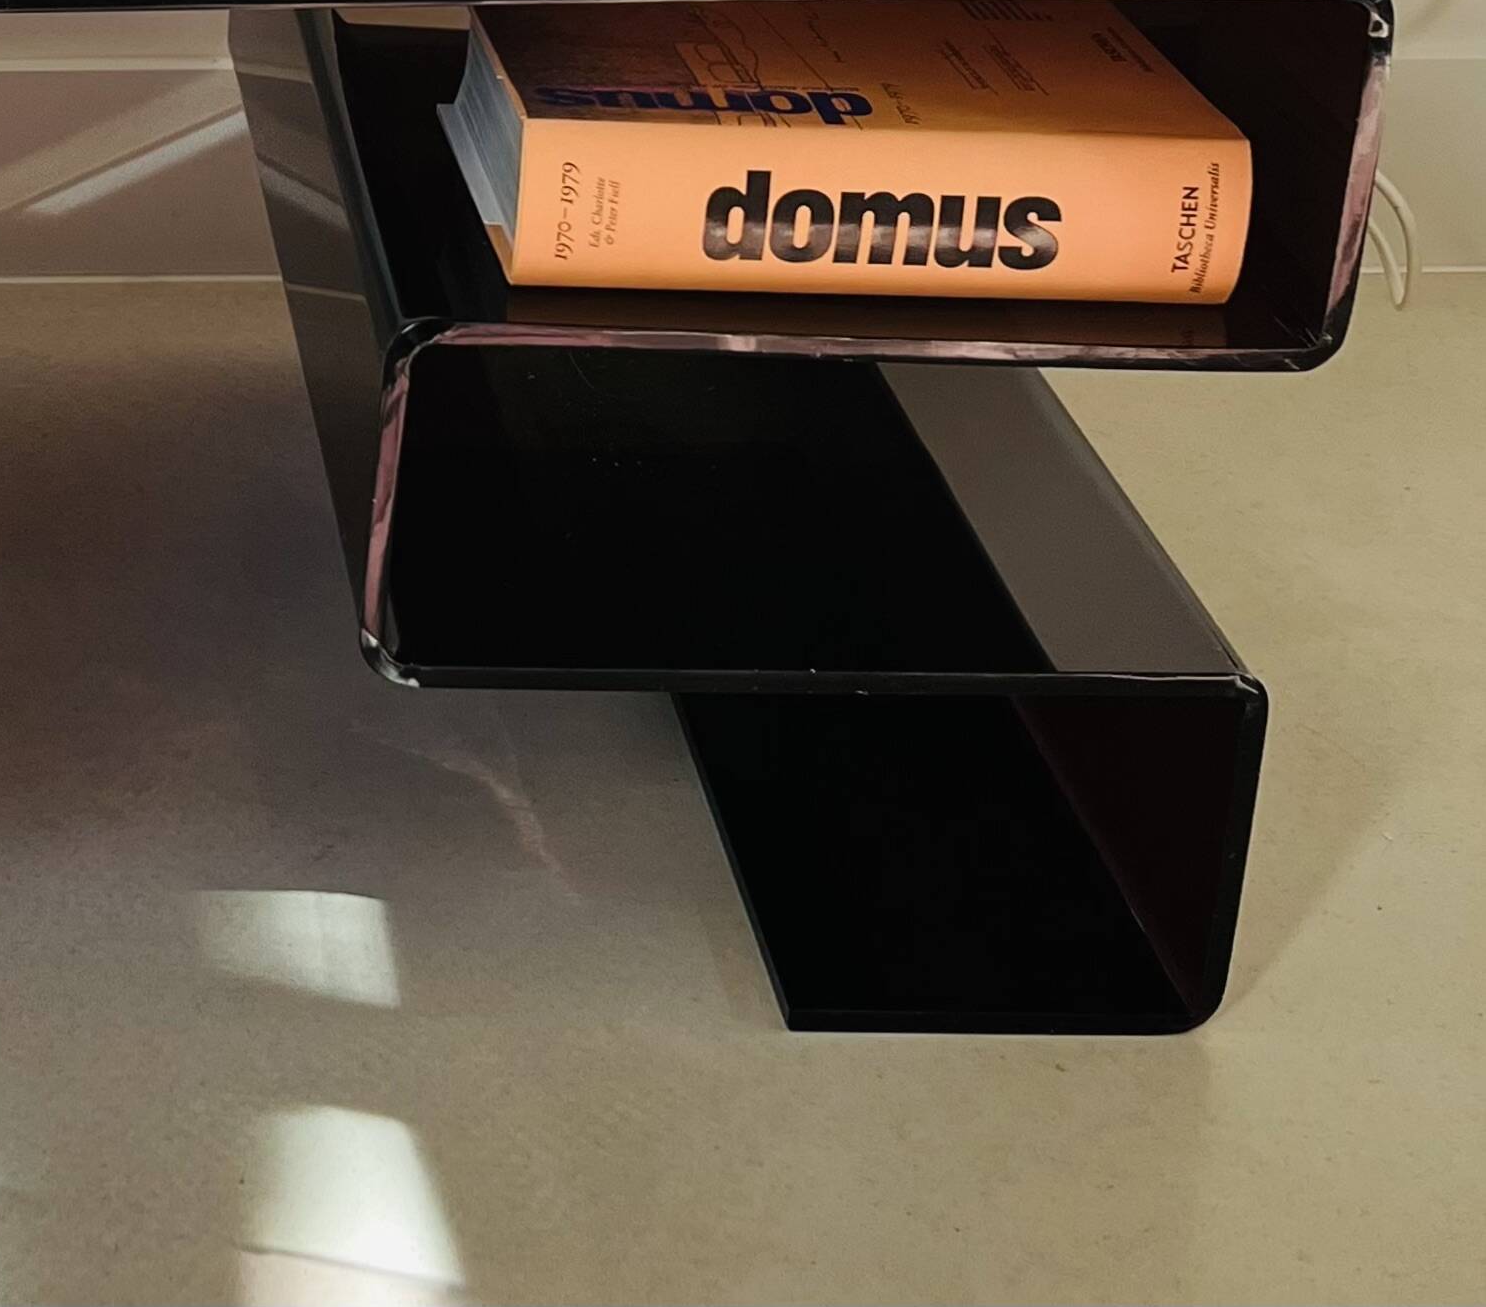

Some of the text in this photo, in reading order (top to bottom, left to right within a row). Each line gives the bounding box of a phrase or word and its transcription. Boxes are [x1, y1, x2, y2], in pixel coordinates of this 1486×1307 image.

[536, 88, 872, 124] domus
[591, 177, 605, 225] Charlotte
[605, 180, 620, 245] & Peter Fiell
[703, 170, 1062, 270] domus
[1171, 186, 1199, 273] TASCHEN
[1189, 162, 1220, 294] Bibliotheca Universalis
